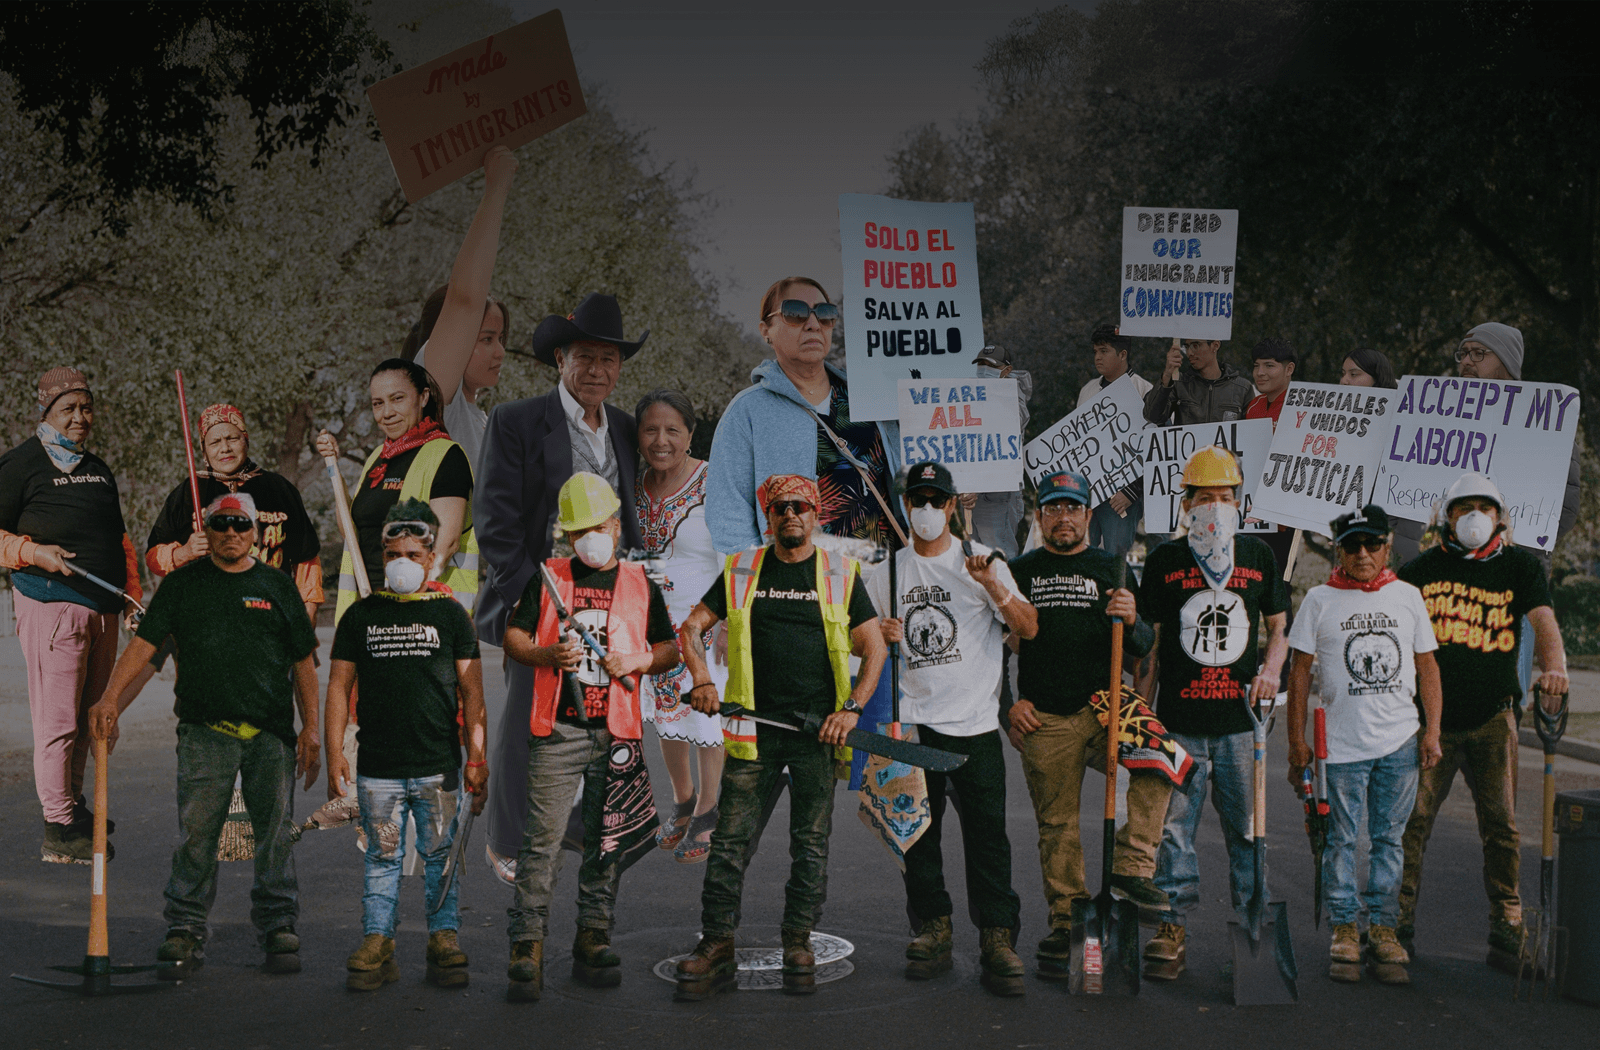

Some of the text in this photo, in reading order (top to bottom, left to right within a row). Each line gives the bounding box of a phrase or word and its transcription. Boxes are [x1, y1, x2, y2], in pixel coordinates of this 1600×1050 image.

[463, 91, 481, 108] by
[409, 79, 573, 180] IMMIGRANTS
[1137, 212, 1222, 234] DEFEND
[864, 222, 955, 252] SOLO EL
[1152, 238, 1202, 260] OUR
[864, 260, 957, 289] PUEBLO
[1125, 263, 1234, 285] IMMIGRANT
[864, 298, 960, 320] SALVA AL
[1122, 286, 1234, 319] COMMUNITIES
[867, 327, 962, 357] PUEBLO
[909, 385, 987, 405] WE ARE
[1285, 388, 1389, 417] ESENCIALES
[1397, 378, 1580, 431] ACCEPT MY
[929, 405, 982, 430] ALL
[1101, 412, 1131, 443] TO
[1296, 411, 1372, 437] Y UNIDOS
[1025, 396, 1118, 470] WORKERS
[1145, 423, 1244, 462] ALTO AL
[1301, 433, 1338, 458] POR
[903, 433, 1021, 465] ESSENTIALS!
[1100, 433, 1144, 474] WAG
[53, 476, 69, 486] no
[1263, 453, 1364, 510] JUSTICIA
[1164, 569, 1186, 584] LOS
[1182, 577, 1206, 589] DEL
[754, 587, 812, 601] no borders
[1453, 581, 1469, 597] EL
[1469, 585, 1514, 607] PUEBLO
[1485, 604, 1515, 630] AL
[1431, 617, 1516, 653] UEBLO
[1201, 666, 1231, 674] FEAR
[1190, 679, 1240, 689] BROWN
